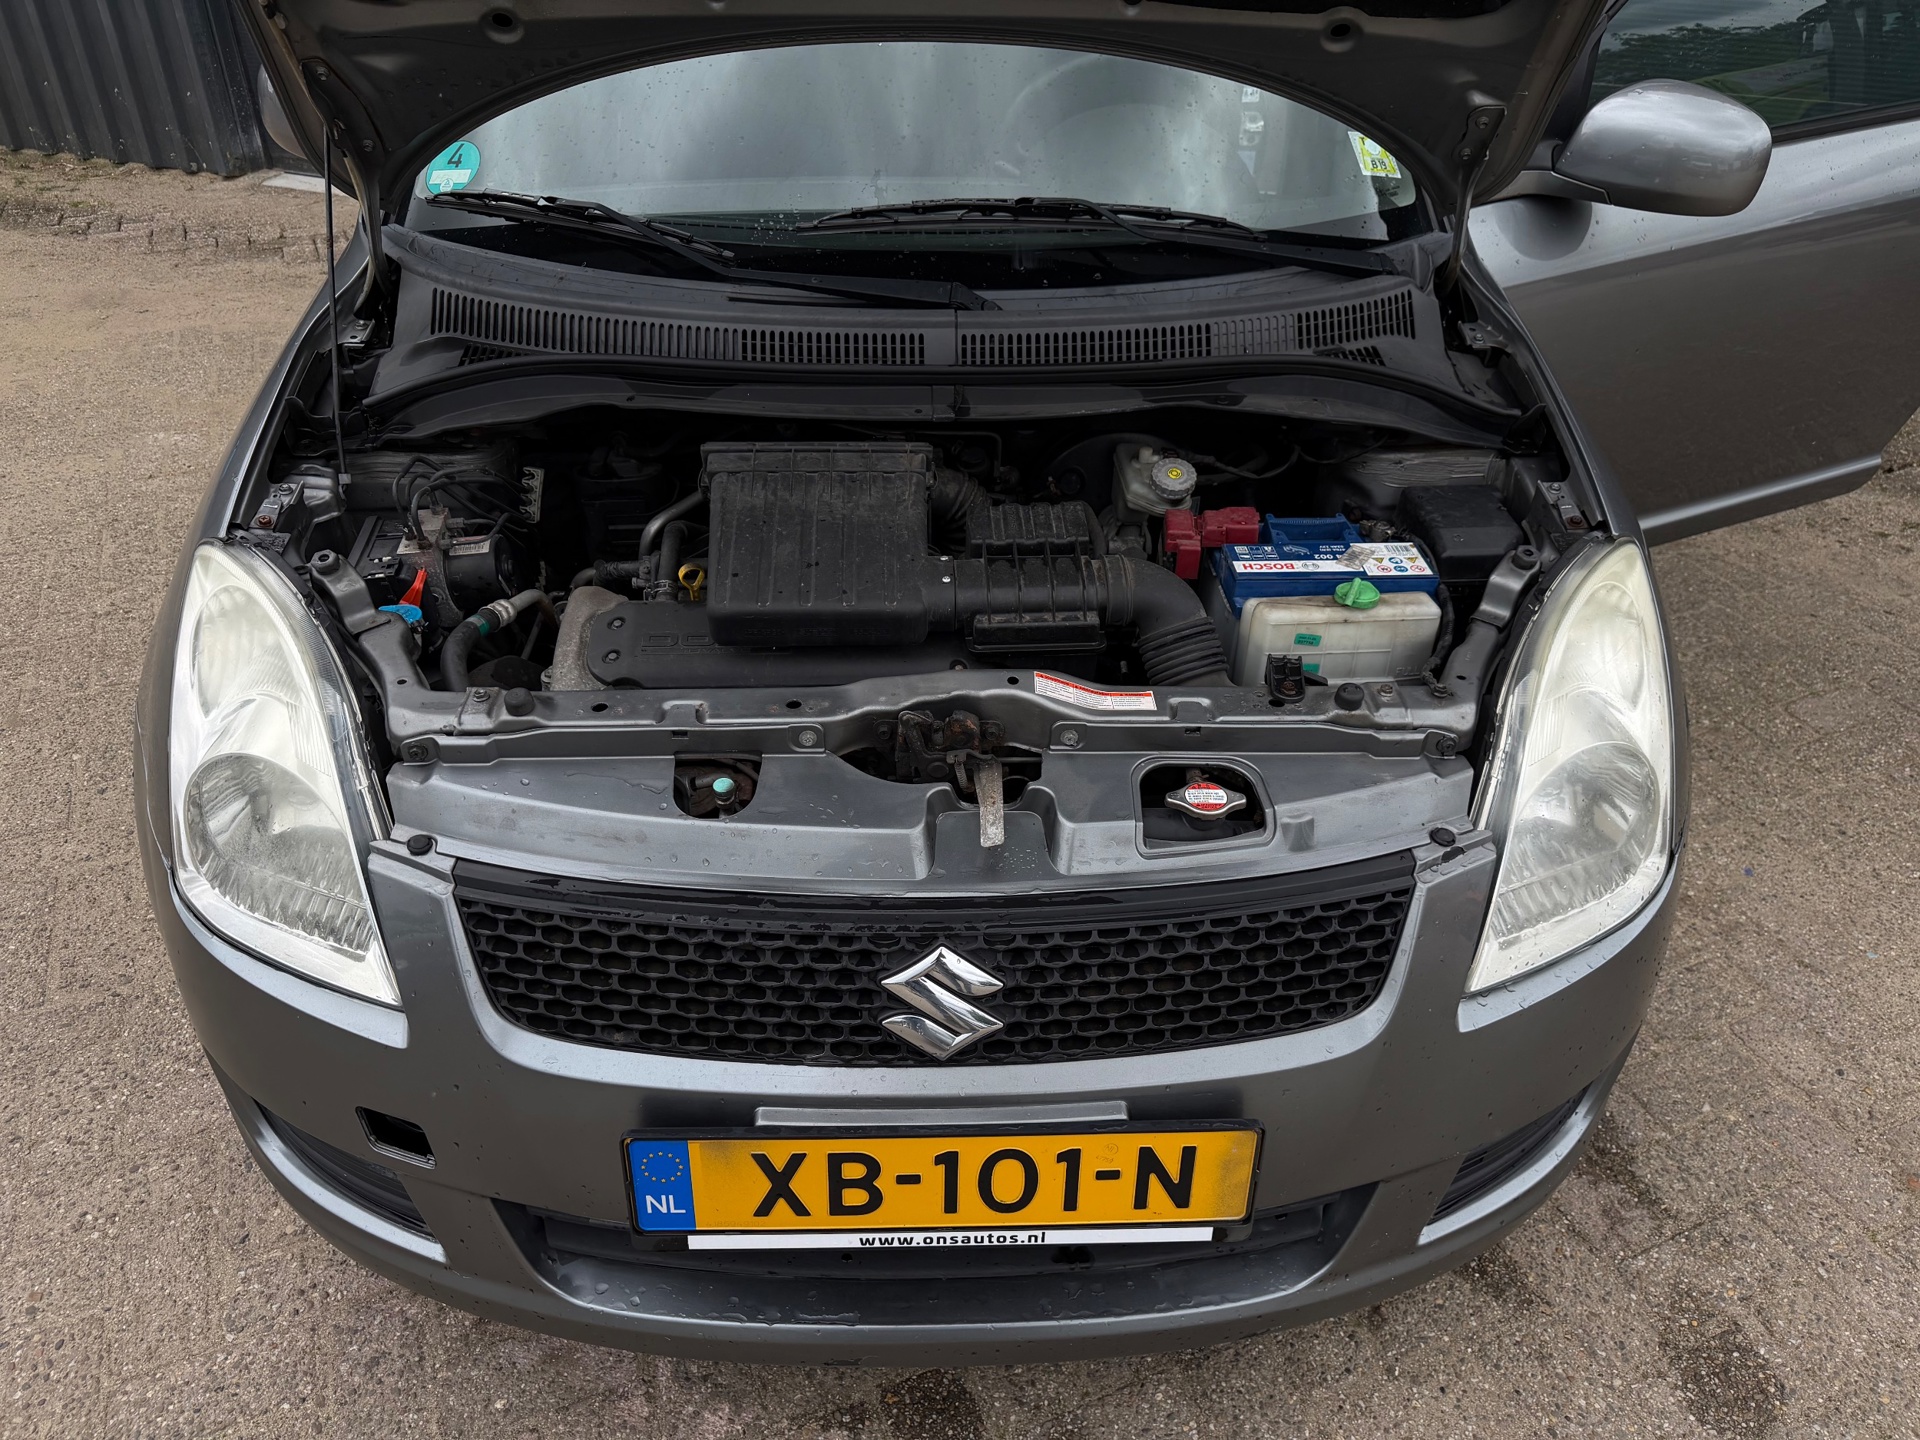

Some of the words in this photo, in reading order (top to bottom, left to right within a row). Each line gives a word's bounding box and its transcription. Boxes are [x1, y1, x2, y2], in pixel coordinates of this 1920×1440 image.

[447, 143, 465, 168] 4
[1242, 562, 1295, 571] BOSCH
[641, 630, 716, 647] DO
[750, 1145, 1198, 1217] XB-101-N
[645, 1194, 686, 1214] NL
[859, 1230, 1046, 1247] www.onsautos.nl
